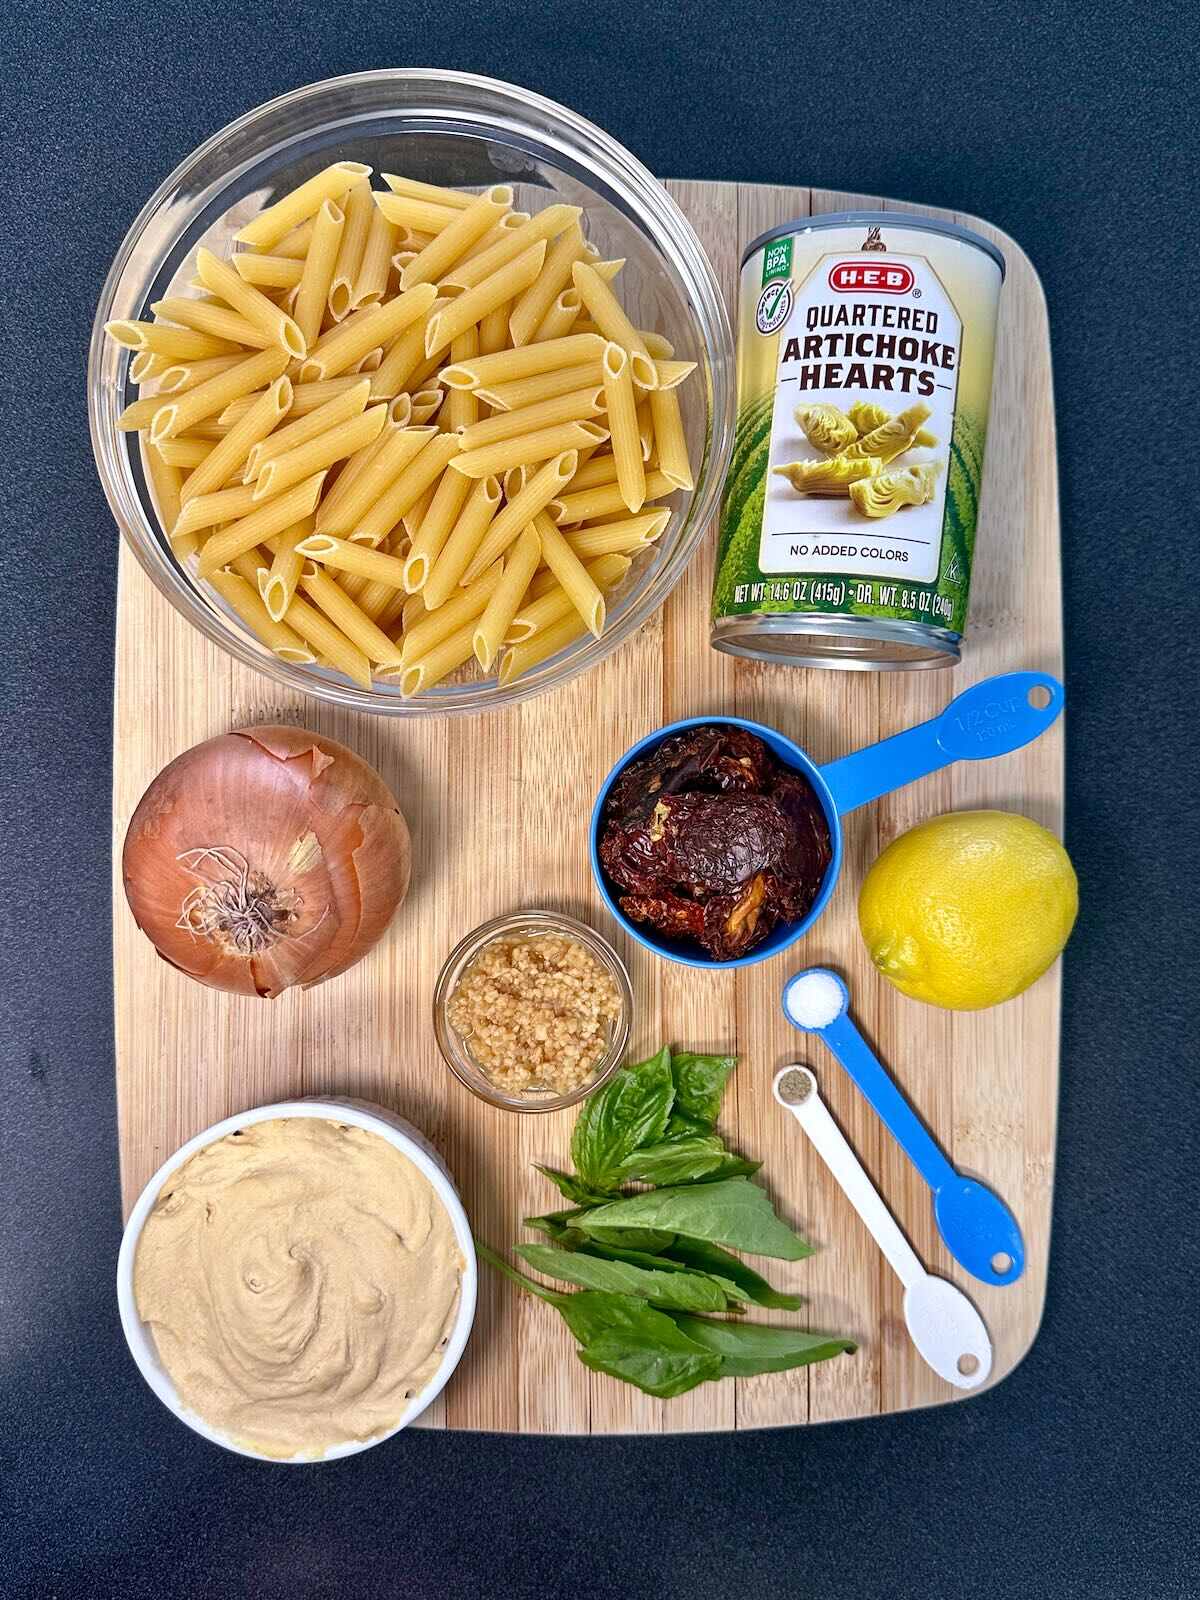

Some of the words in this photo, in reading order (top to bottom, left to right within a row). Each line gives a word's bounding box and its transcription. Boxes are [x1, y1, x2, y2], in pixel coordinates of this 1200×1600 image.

[766, 253, 787, 271] BPA
[806, 304, 938, 334] QUARTERED
[782, 333, 956, 370] ARTICHOKE
[799, 363, 937, 397] HEARTS
[790, 544, 808, 556] NO
[812, 545, 856, 558] ADDED
[860, 547, 909, 562] COLORS
[734, 584, 748, 604] NET
[751, 582, 767, 601] WT.
[769, 581, 789, 600] 14.6
[793, 581, 807, 600] OZ
[810, 580, 846, 606] (415g)
[856, 584, 875, 604] DR.
[879, 586, 898, 608] WT.
[901, 590, 917, 610] 8.5
[918, 591, 931, 613] OZ
